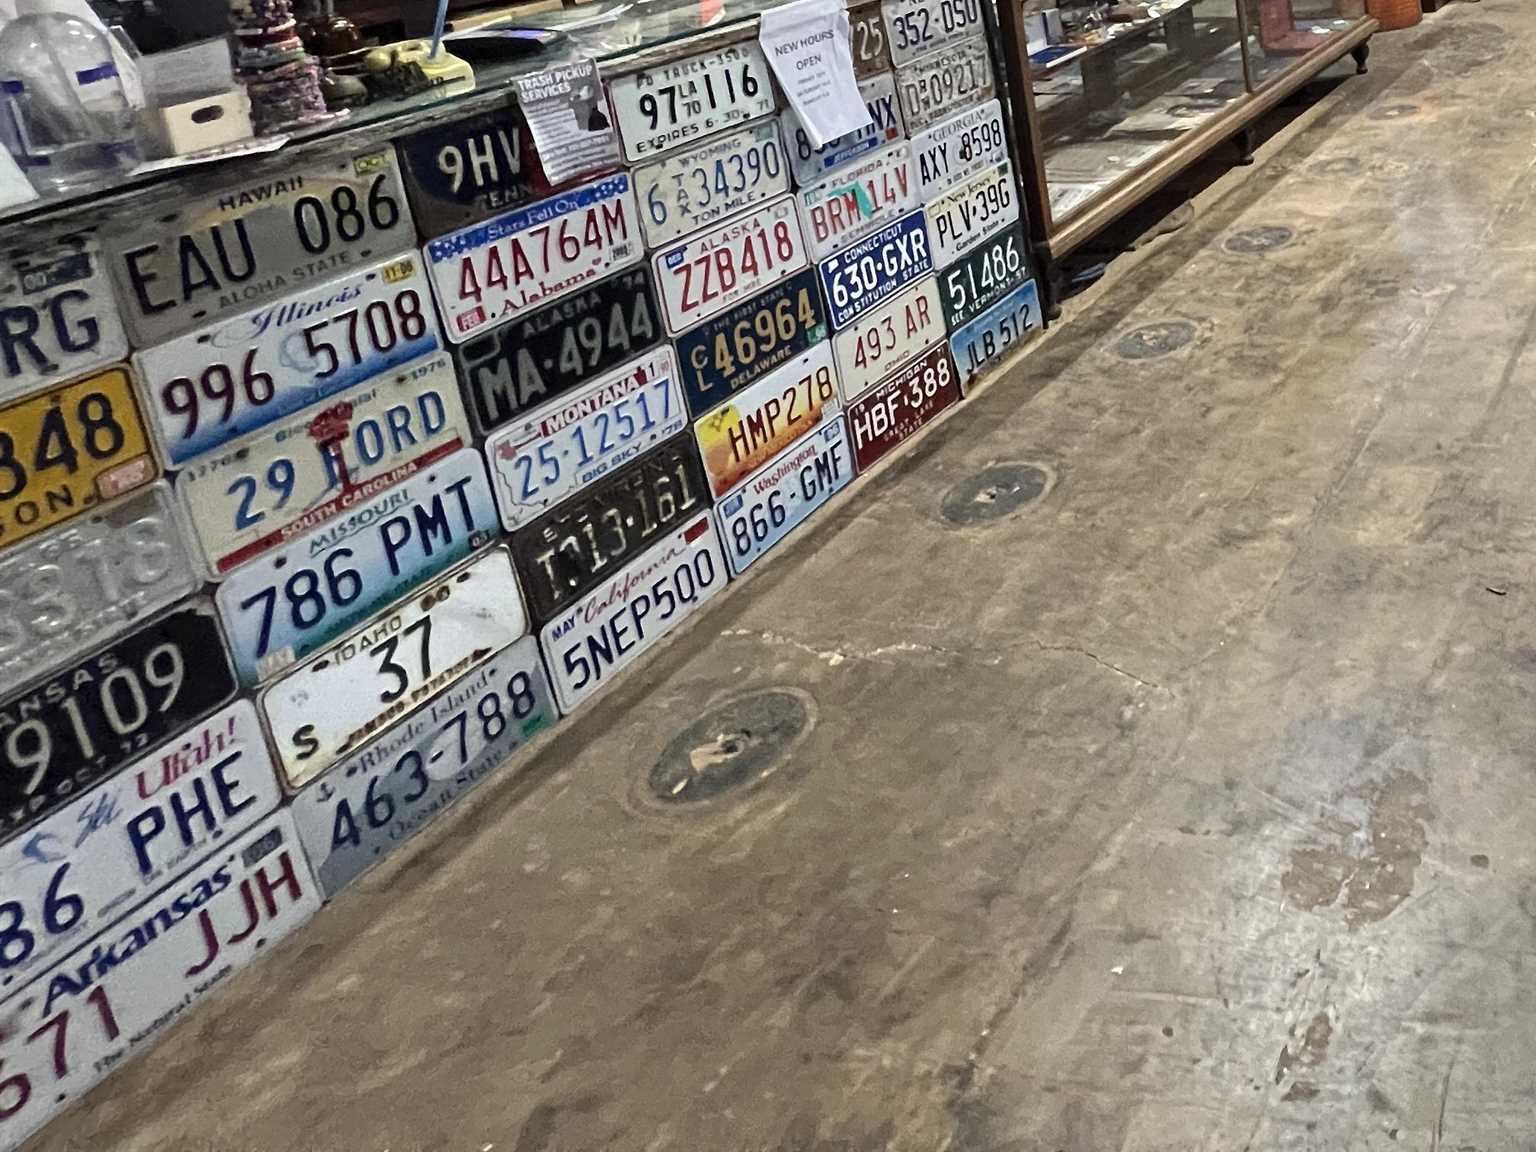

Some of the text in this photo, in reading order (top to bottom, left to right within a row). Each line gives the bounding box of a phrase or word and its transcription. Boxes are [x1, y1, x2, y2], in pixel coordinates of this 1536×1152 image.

[775, 29, 835, 57] NEW HOURS
[795, 54, 822, 71] OPEN
[518, 64, 594, 91] TRASH PICKUP
[520, 81, 572, 104] SERVICES
[678, 80, 698, 99] LA
[638, 85, 678, 130] 97
[682, 99, 702, 118] 70
[932, 111, 983, 142] GEORGIA
[636, 123, 700, 154] EXPIRES
[678, 137, 742, 167] WYOMING
[919, 118, 1002, 186] AXY 8598
[218, 176, 304, 214] HAWAII
[692, 141, 780, 207] 34390
[831, 159, 883, 187] FLORIDA
[487, 195, 580, 242] Stars Fell On
[691, 204, 721, 226] TON
[699, 216, 762, 255] ALASKA
[844, 221, 903, 262] CONNECTICUT
[124, 173, 400, 316] EAU 086
[458, 198, 629, 302] 44A764M
[218, 254, 351, 309] ALOHA STATE
[500, 267, 598, 317] Alabama
[838, 259, 930, 323] CONSTITUTION STATE
[948, 235, 1021, 312] 51486
[248, 284, 364, 337] Illinois
[714, 287, 817, 378] 46964
[853, 294, 932, 370] 493 AR
[965, 303, 1034, 375] JLB 512
[161, 288, 427, 440] 996 5708
[730, 344, 792, 389] DELAWARE
[875, 358, 929, 400] MICHIGAN
[546, 375, 640, 434] MONTANA
[727, 365, 833, 464] HMP278
[582, 441, 643, 484] BIG SKY
[752, 444, 818, 495] Washington
[280, 461, 418, 538] SOUTH CAROLINA
[309, 488, 412, 554] MISSOURI
[732, 440, 843, 558] 866-GMF
[240, 548, 364, 660] 786
[377, 475, 475, 577] PMT
[582, 542, 686, 625] California
[335, 614, 403, 666] IDAHO
[551, 614, 577, 642] MAY
[563, 547, 716, 690] 5NEP500
[369, 613, 433, 705] 37
[5, 642, 185, 796] 9109
[358, 719, 427, 774] Rhode
[431, 668, 490, 723] Island
[126, 750, 259, 878] PHE
[41, 857, 238, 1020] Arkansas
[185, 851, 305, 980] JJH
[128, 996, 193, 1045] Natural
[193, 964, 233, 996] State
